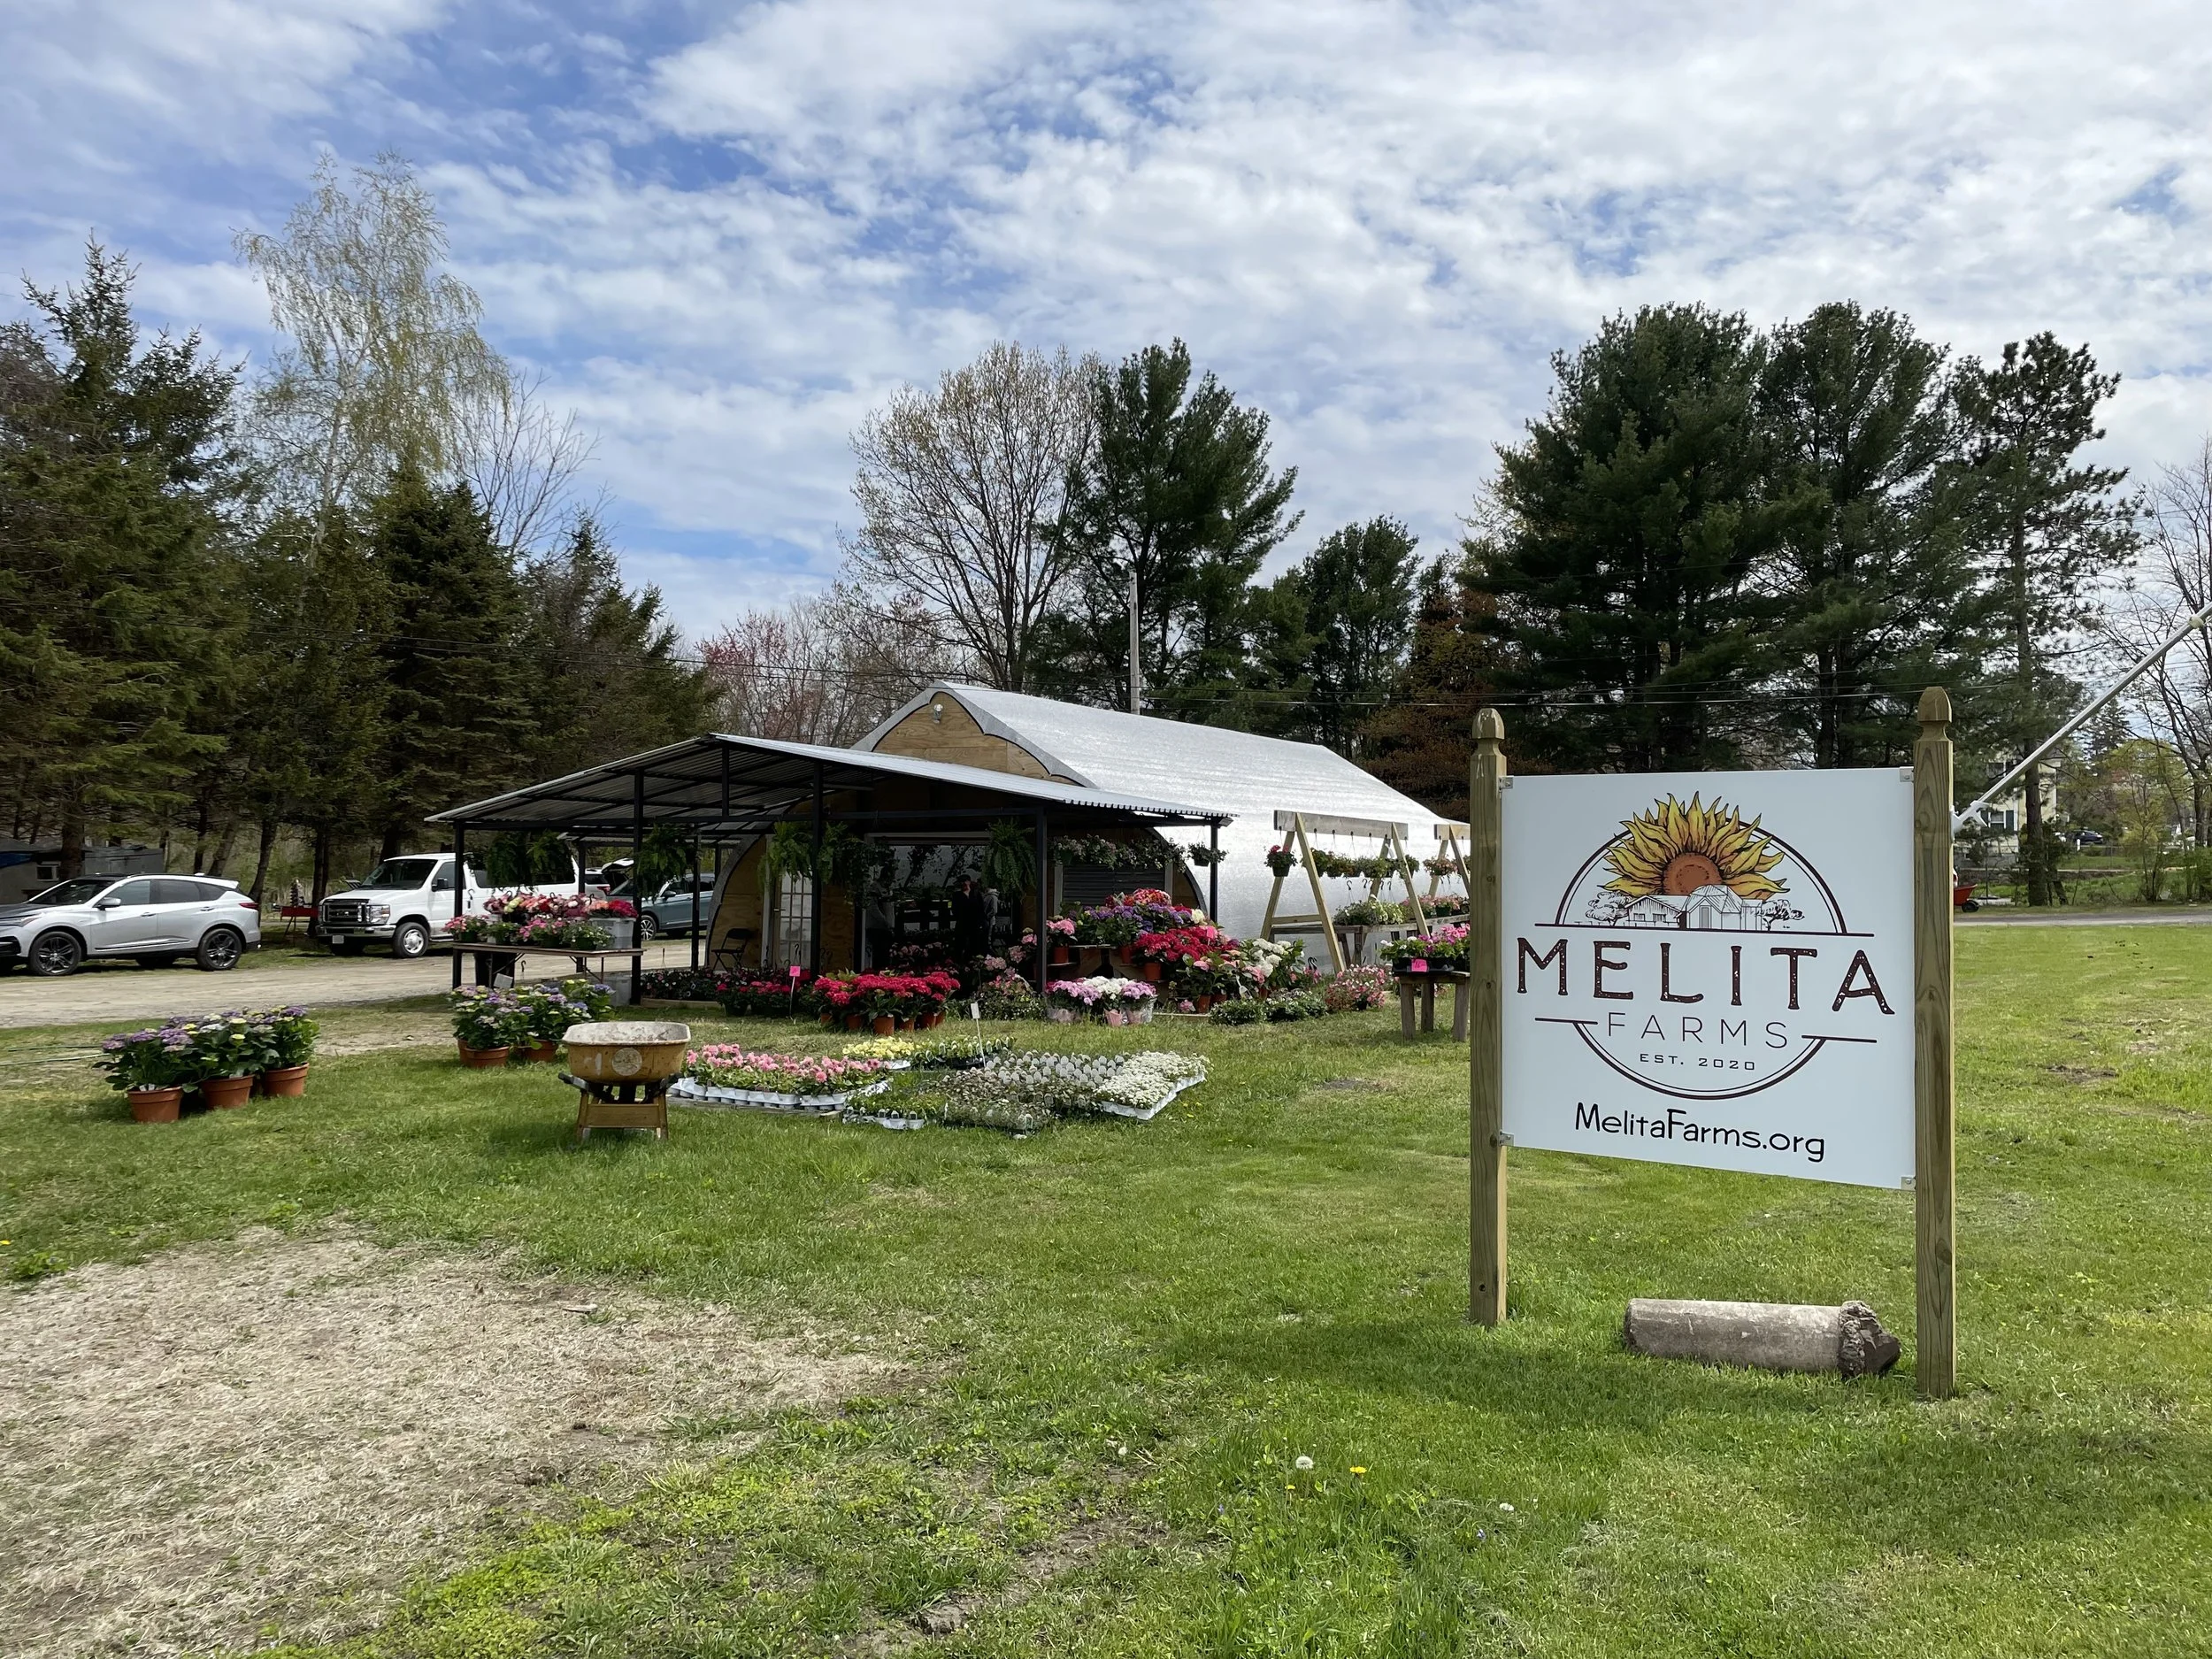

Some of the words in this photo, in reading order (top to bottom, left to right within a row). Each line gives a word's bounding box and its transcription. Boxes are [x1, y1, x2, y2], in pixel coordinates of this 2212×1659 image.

[1517, 937, 1895, 1015] MELITA
[1607, 1011, 1788, 1049] FARMS
[1640, 1053, 1685, 1065] EST.
[1698, 1057, 1755, 1071] 2020
[1575, 1102, 1825, 1164] MelitaFarms.org
